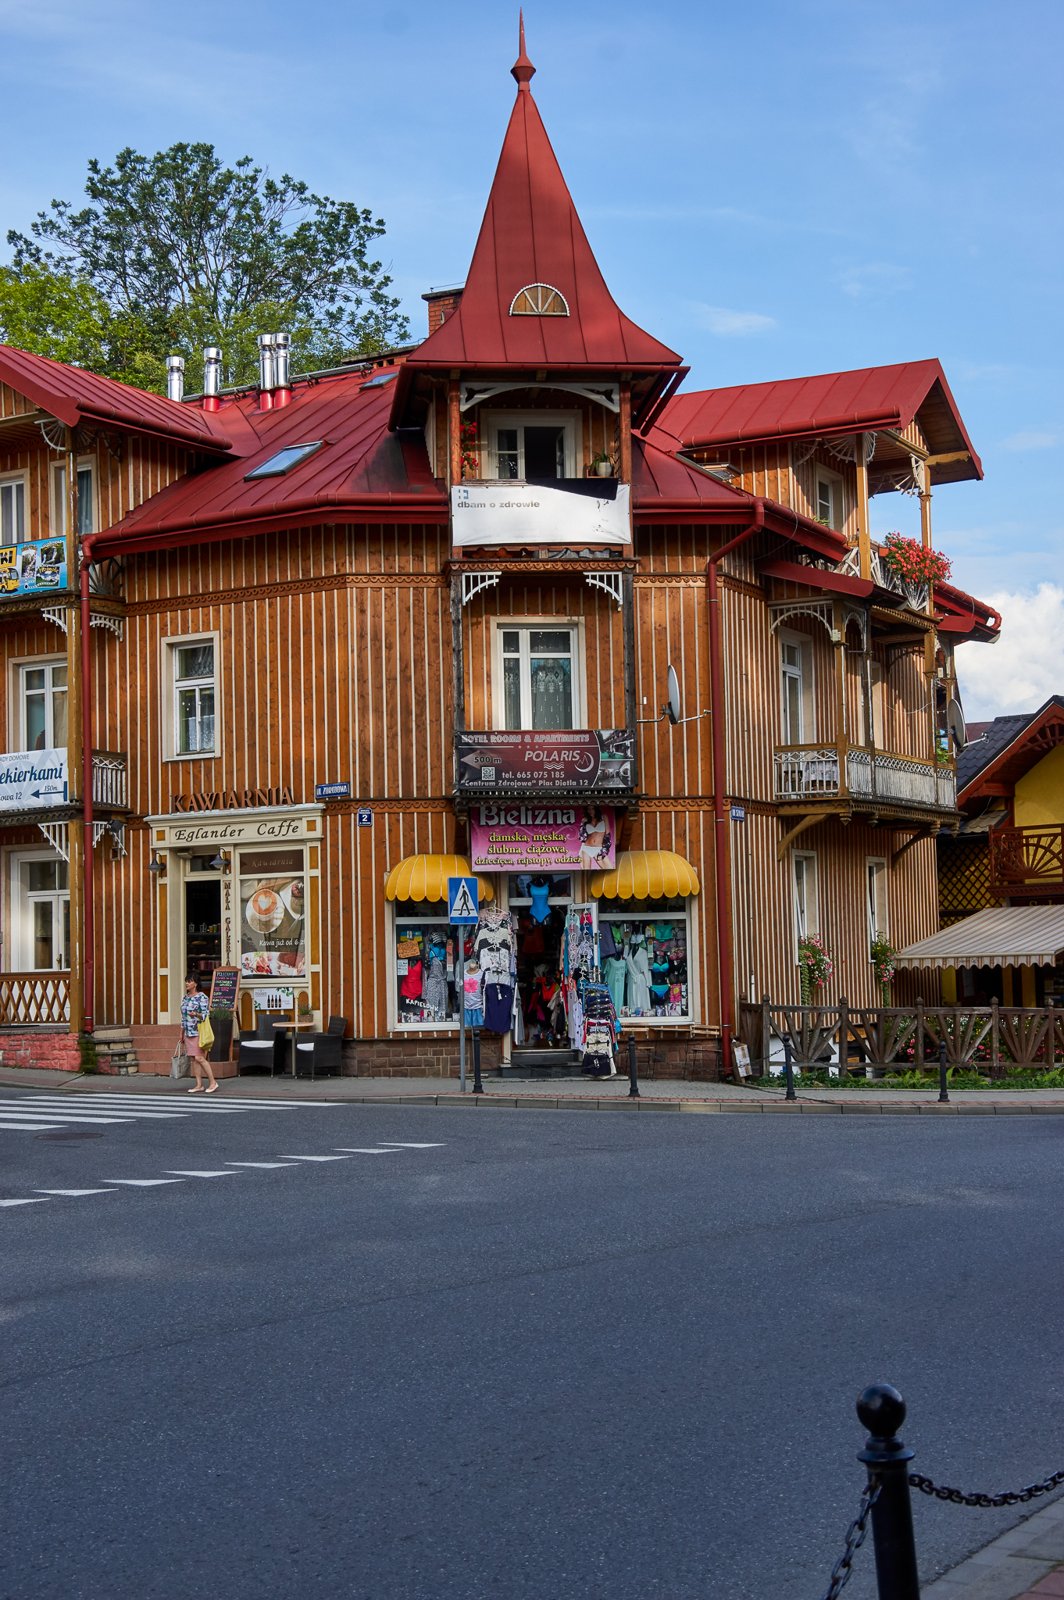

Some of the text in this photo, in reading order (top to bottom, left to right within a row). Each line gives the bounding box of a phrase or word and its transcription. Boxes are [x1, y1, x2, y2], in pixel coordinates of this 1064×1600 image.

[462, 734, 589, 743] HOTEL ROOMS & APARTMENTS
[524, 750, 580, 761] POLARIS
[0, 763, 63, 785] ekierkami
[15, 791, 23, 799] 12
[173, 786, 295, 812] KAWIARNIA
[362, 814, 368, 822] 2
[479, 806, 576, 826] Bielizna
[175, 820, 299, 842] Eglander Caffe
[489, 832, 567, 844] damska, męska,
[488, 844, 569, 856] ślubna, ciążowa,
[285, 937, 293, 946] od
